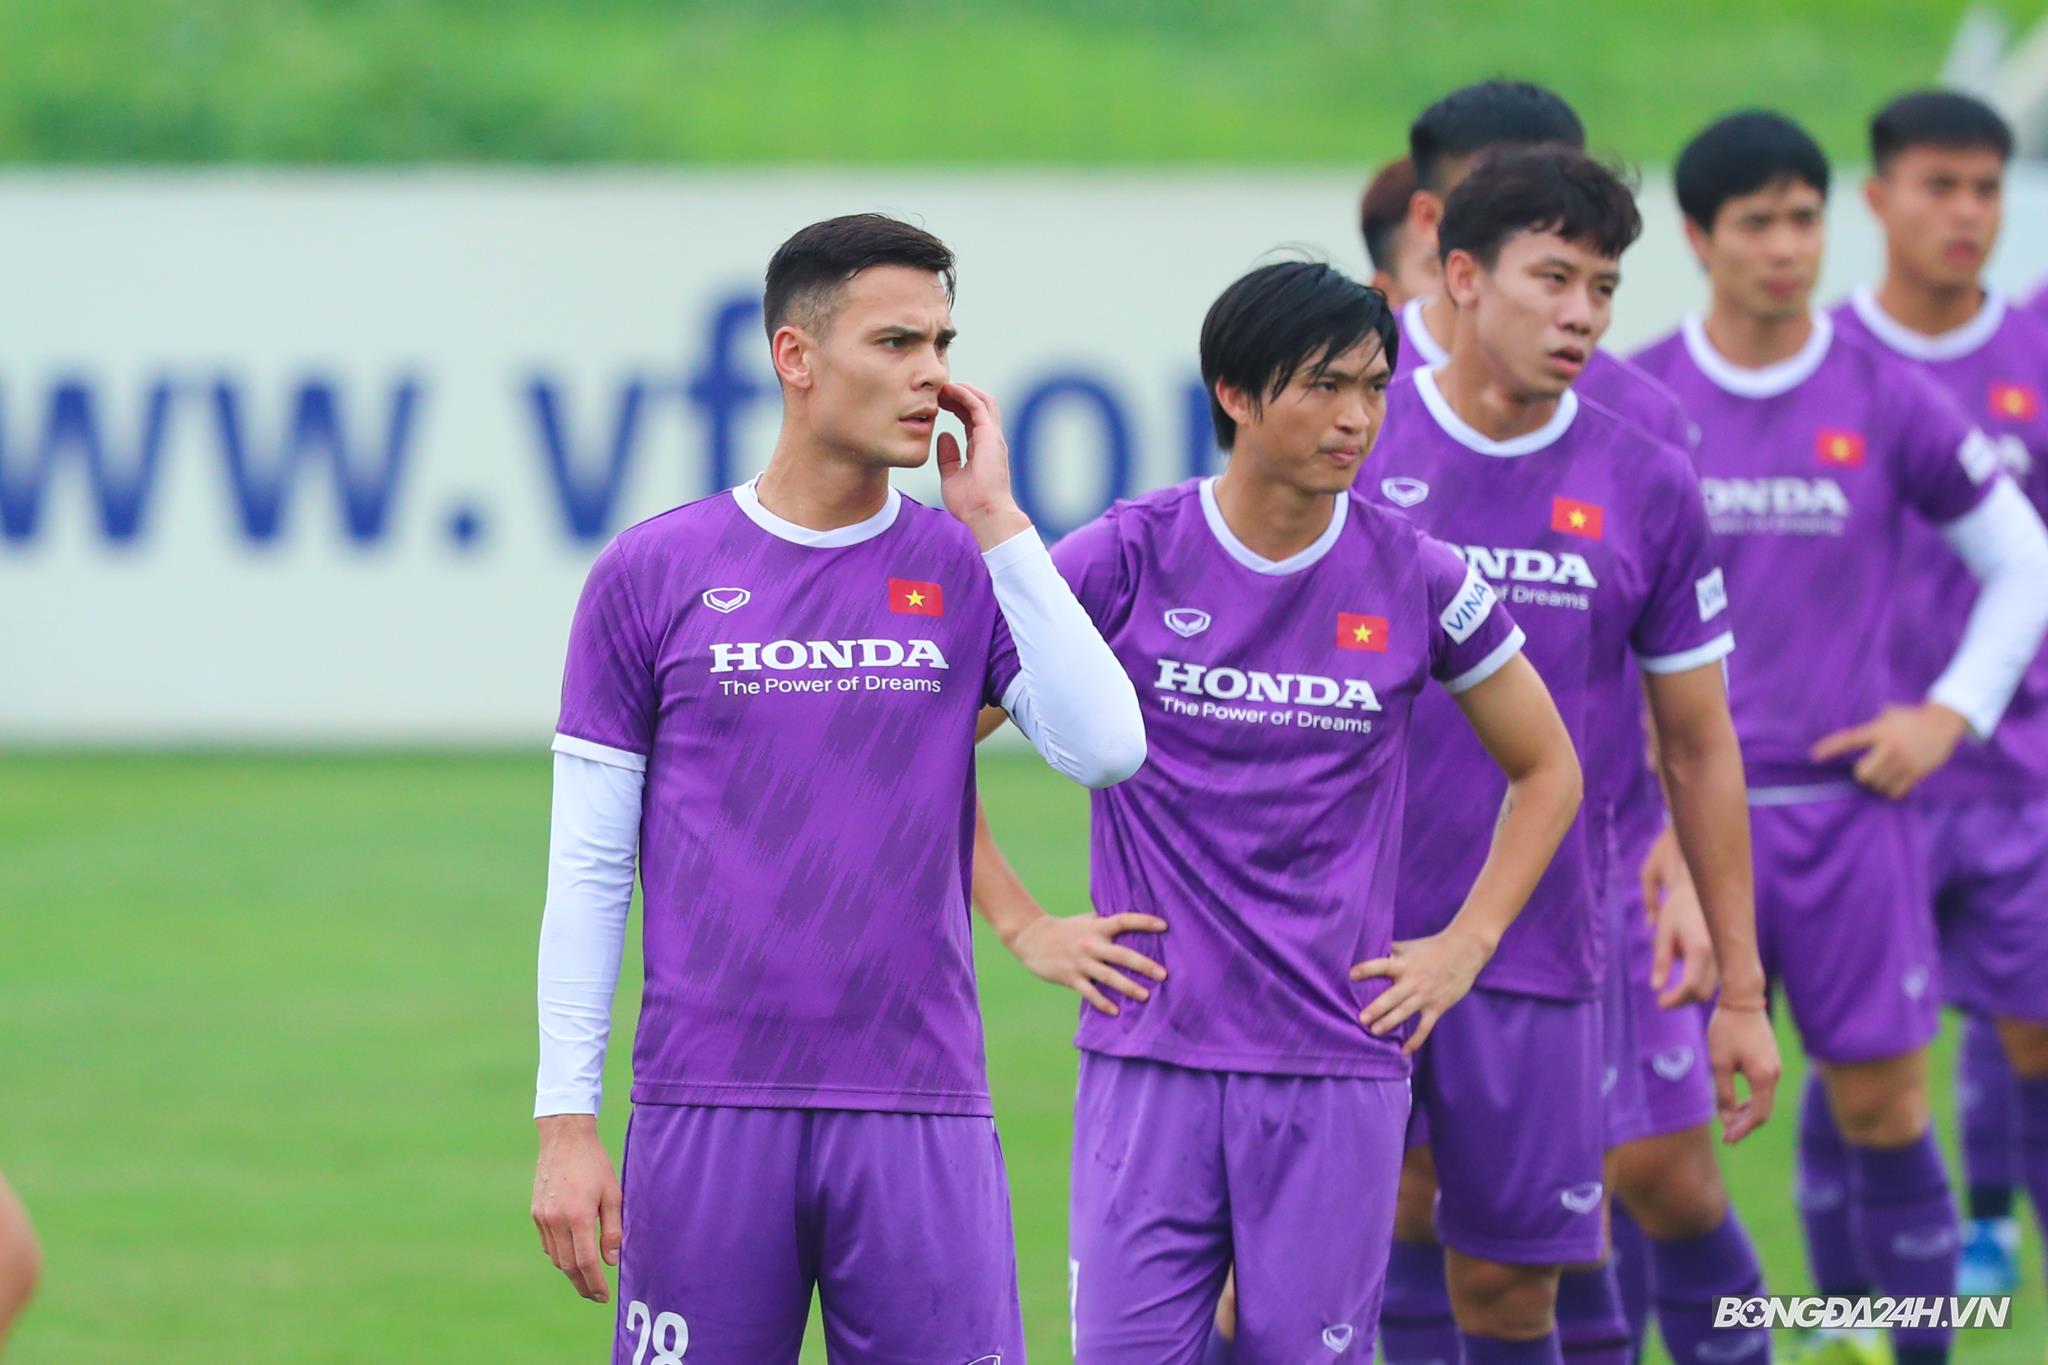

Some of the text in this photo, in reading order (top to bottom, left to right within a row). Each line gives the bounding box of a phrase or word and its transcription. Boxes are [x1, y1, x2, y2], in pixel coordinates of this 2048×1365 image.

[1446, 542, 1598, 589] NDA
[1447, 582, 1488, 631] VINA
[1511, 584, 1590, 611] Dreams
[709, 639, 949, 673] HONDA
[719, 675, 941, 696] The Power of Dreams
[1154, 658, 1383, 712] HONDA
[1160, 696, 1373, 734] The Power of Dreams
[626, 1300, 689, 1365] 28
